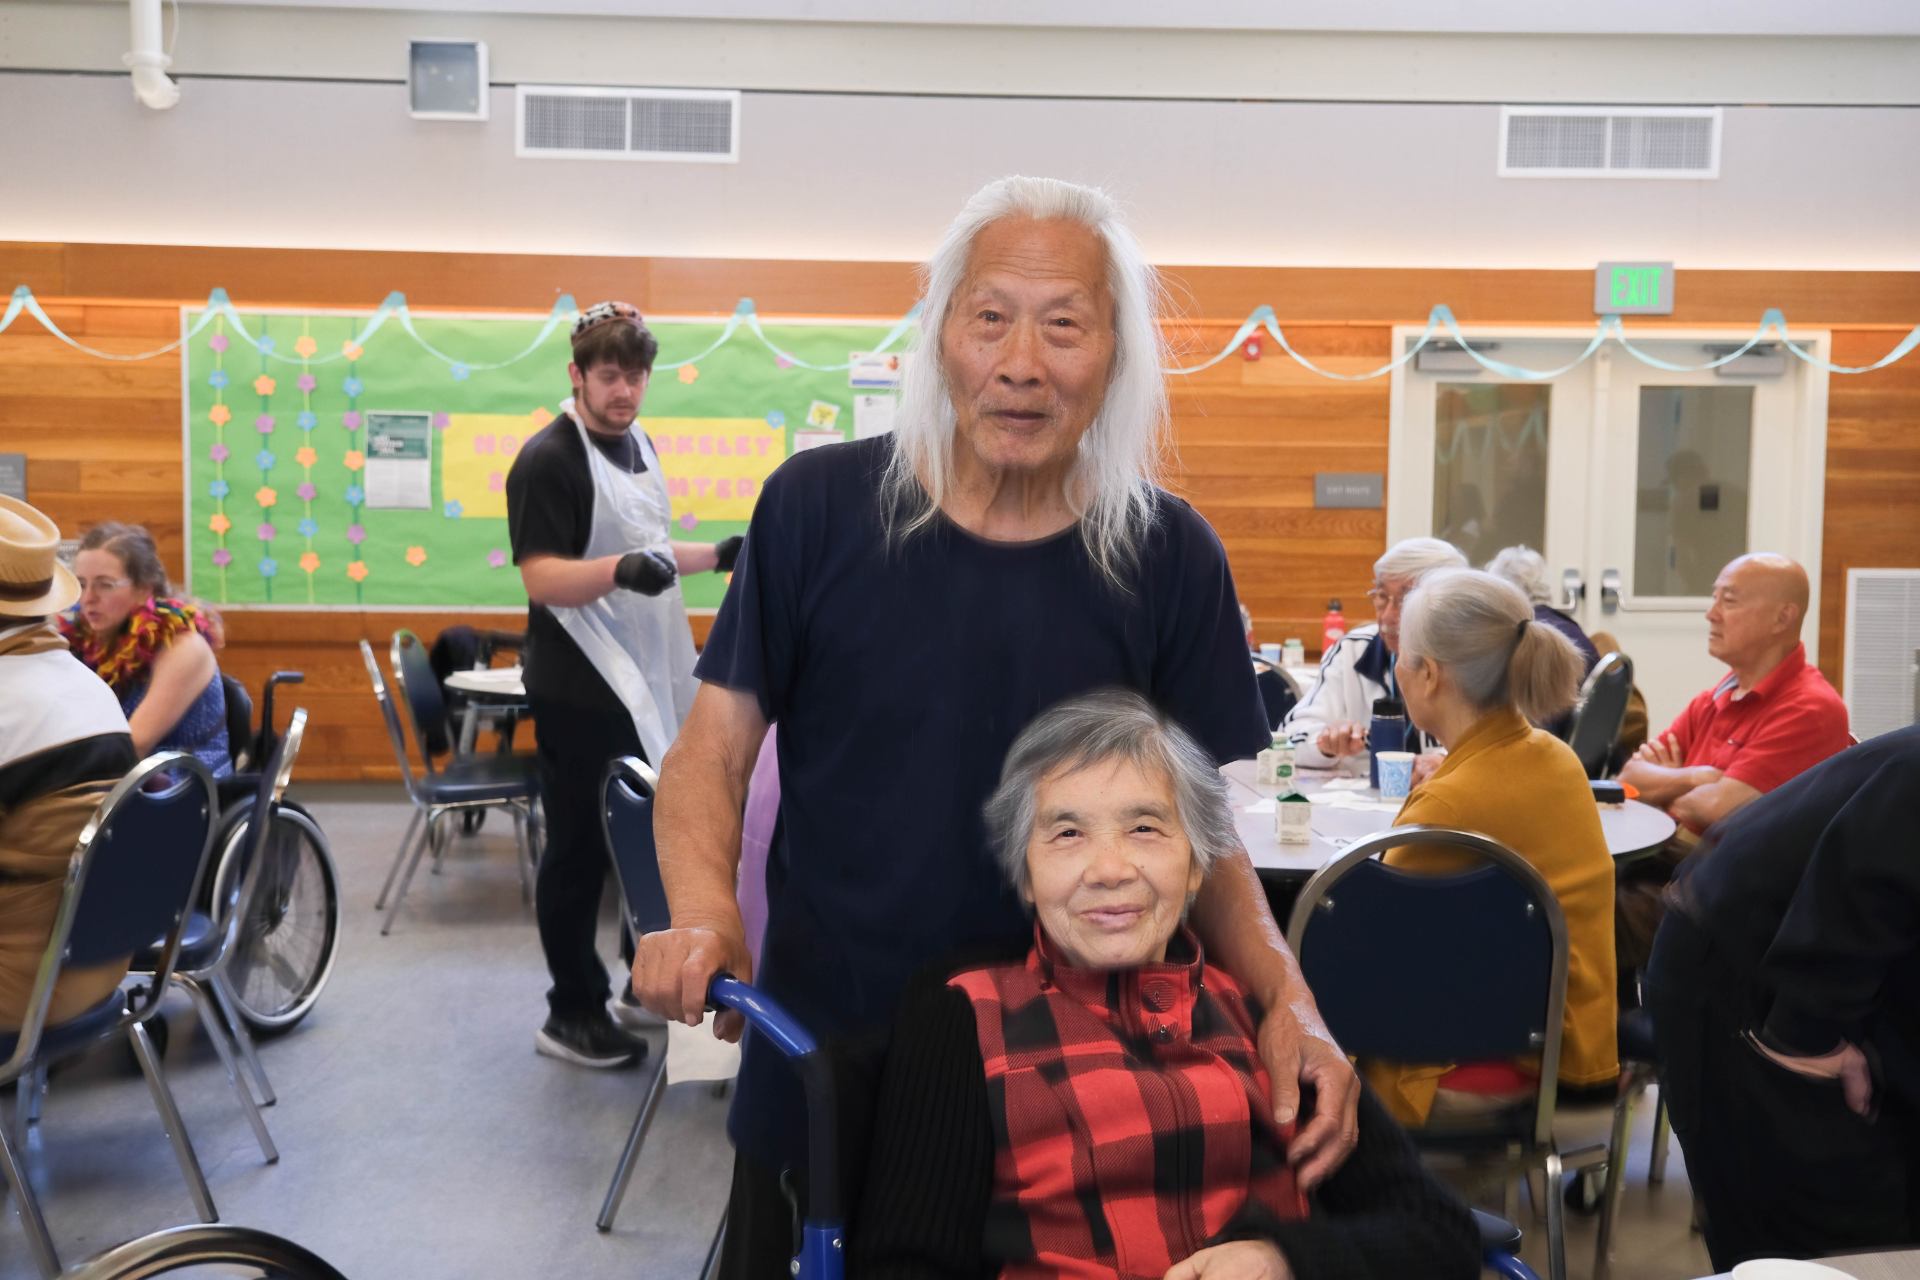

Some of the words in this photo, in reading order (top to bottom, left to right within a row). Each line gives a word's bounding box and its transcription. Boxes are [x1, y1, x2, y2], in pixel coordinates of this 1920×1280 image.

[1610, 267, 1664, 306] EXIT
[655, 435, 772, 456] RKELEY
[667, 477, 756, 498] NTER
